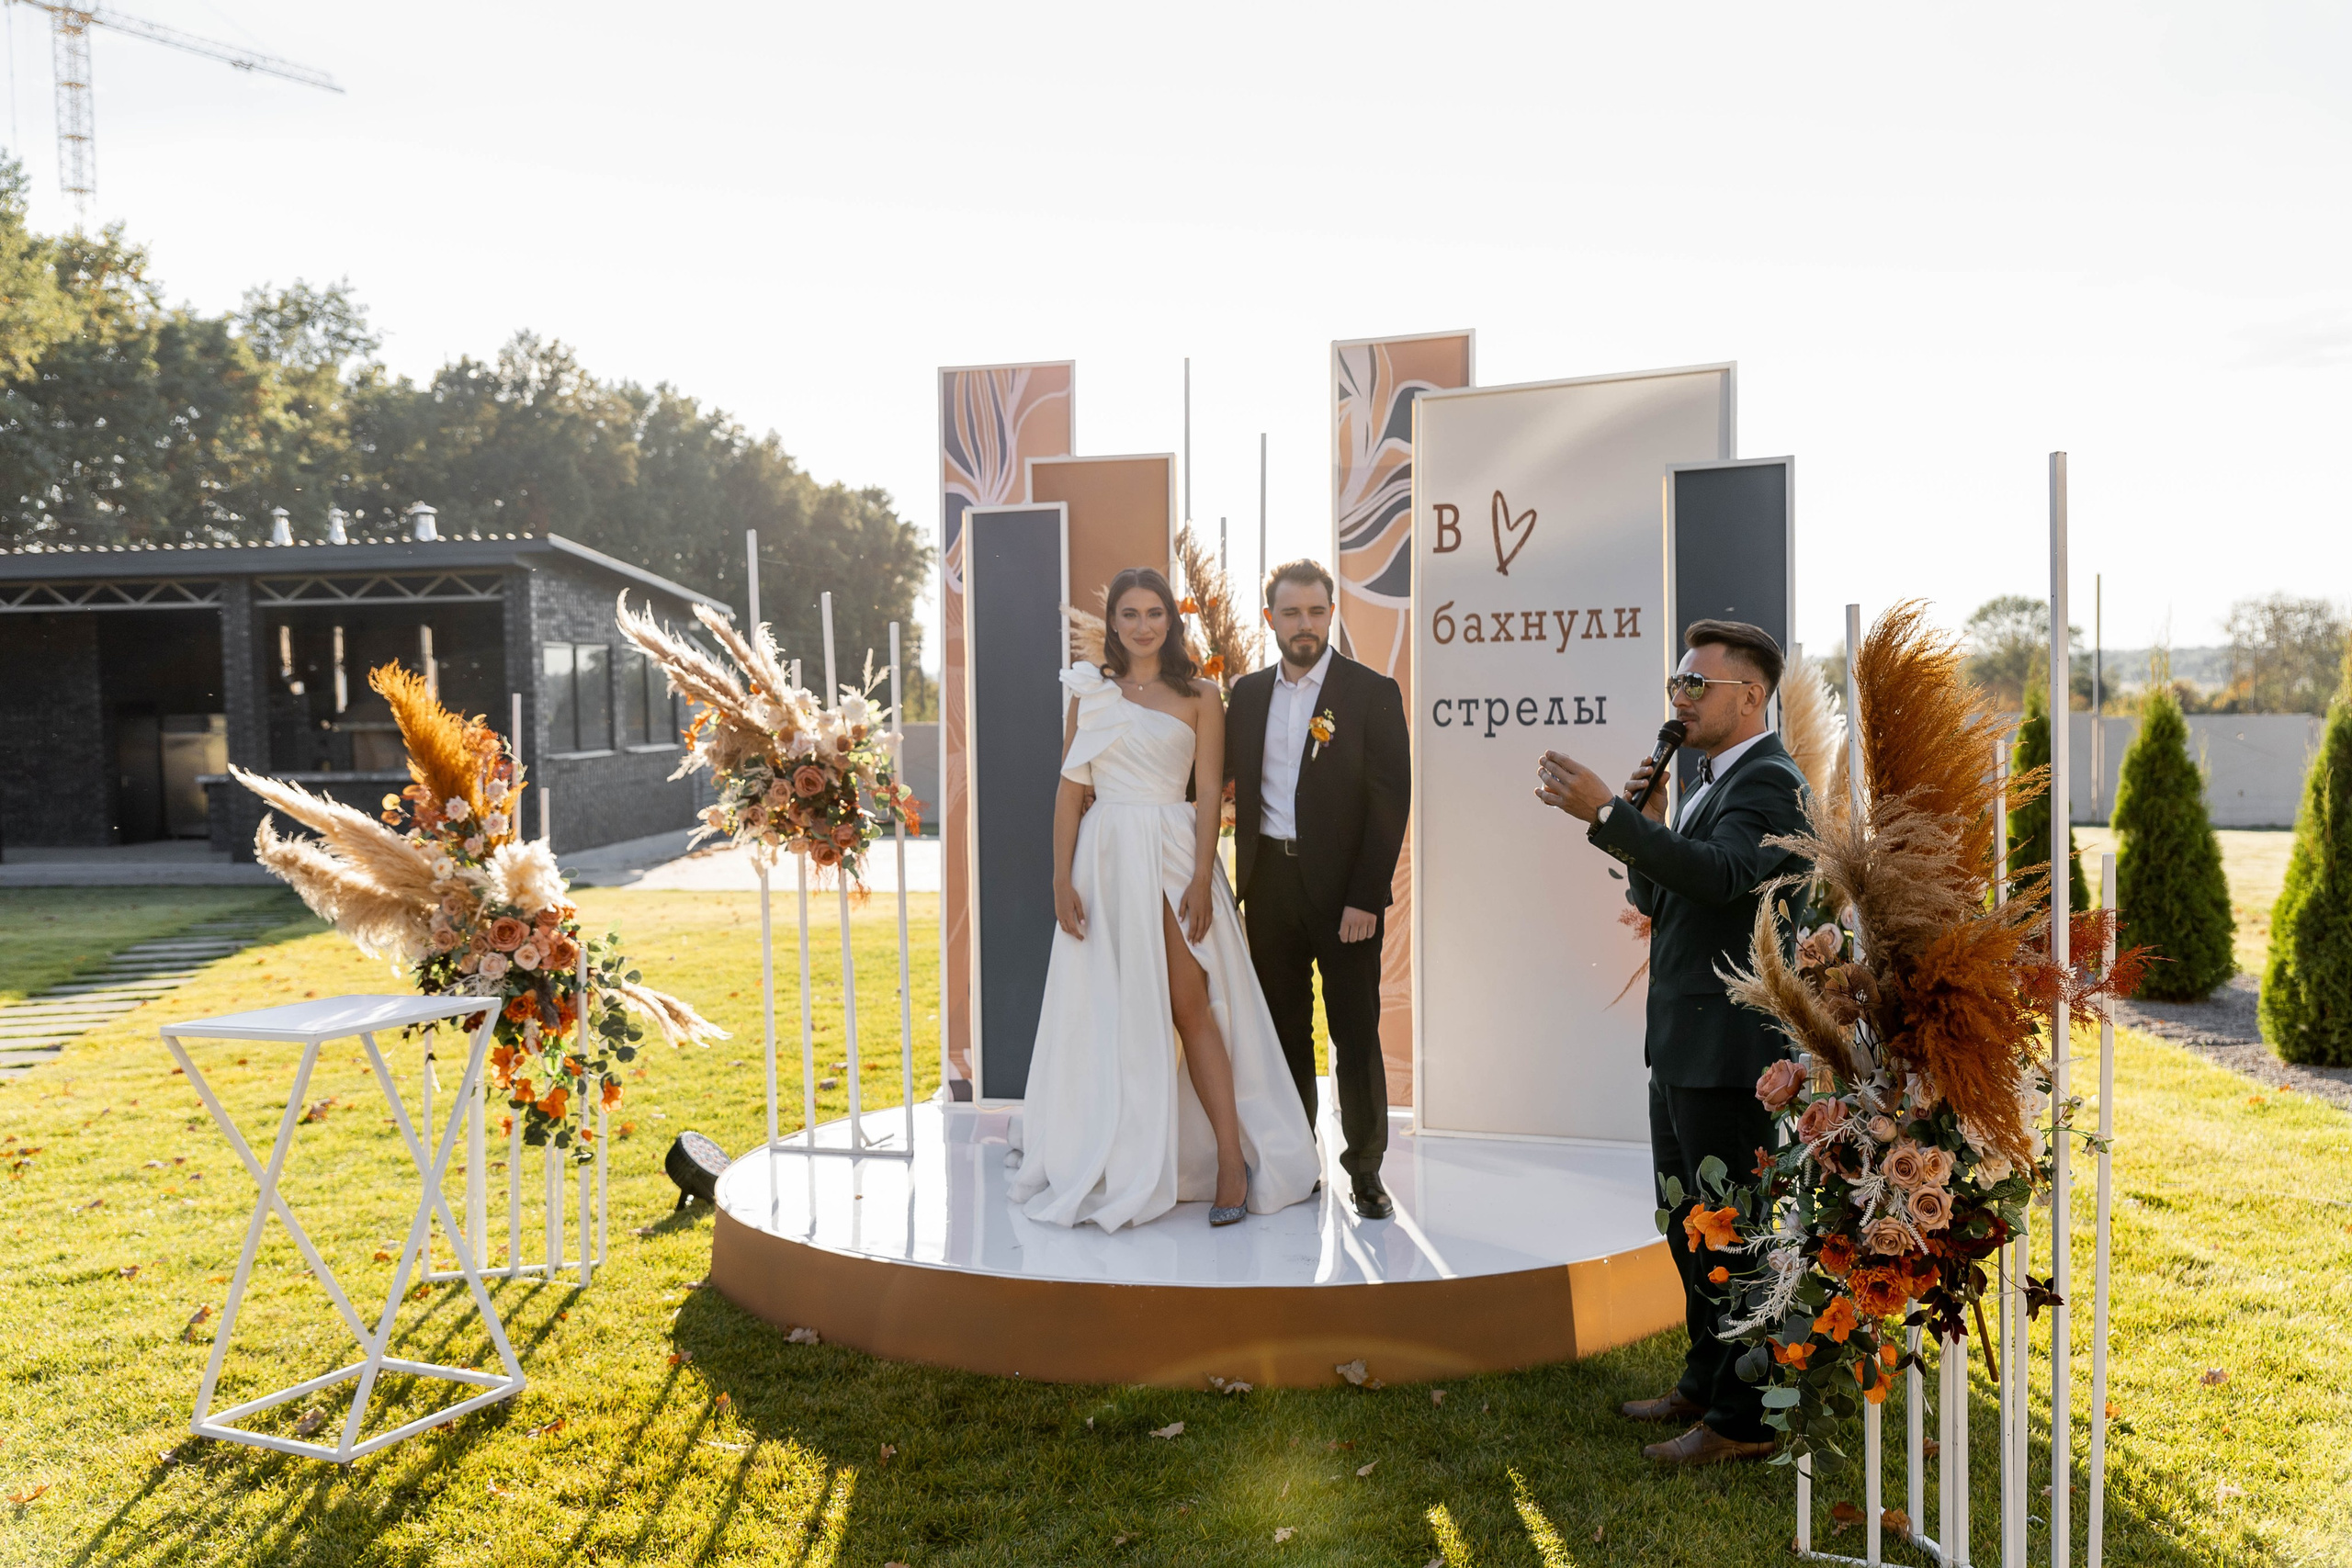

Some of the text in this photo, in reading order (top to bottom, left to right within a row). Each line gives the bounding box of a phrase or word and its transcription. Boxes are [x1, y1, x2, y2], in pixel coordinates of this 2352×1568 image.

[1432, 503, 1462, 553] В
[1432, 601, 1642, 653] бахнули
[1432, 695, 1607, 738] стрелы
